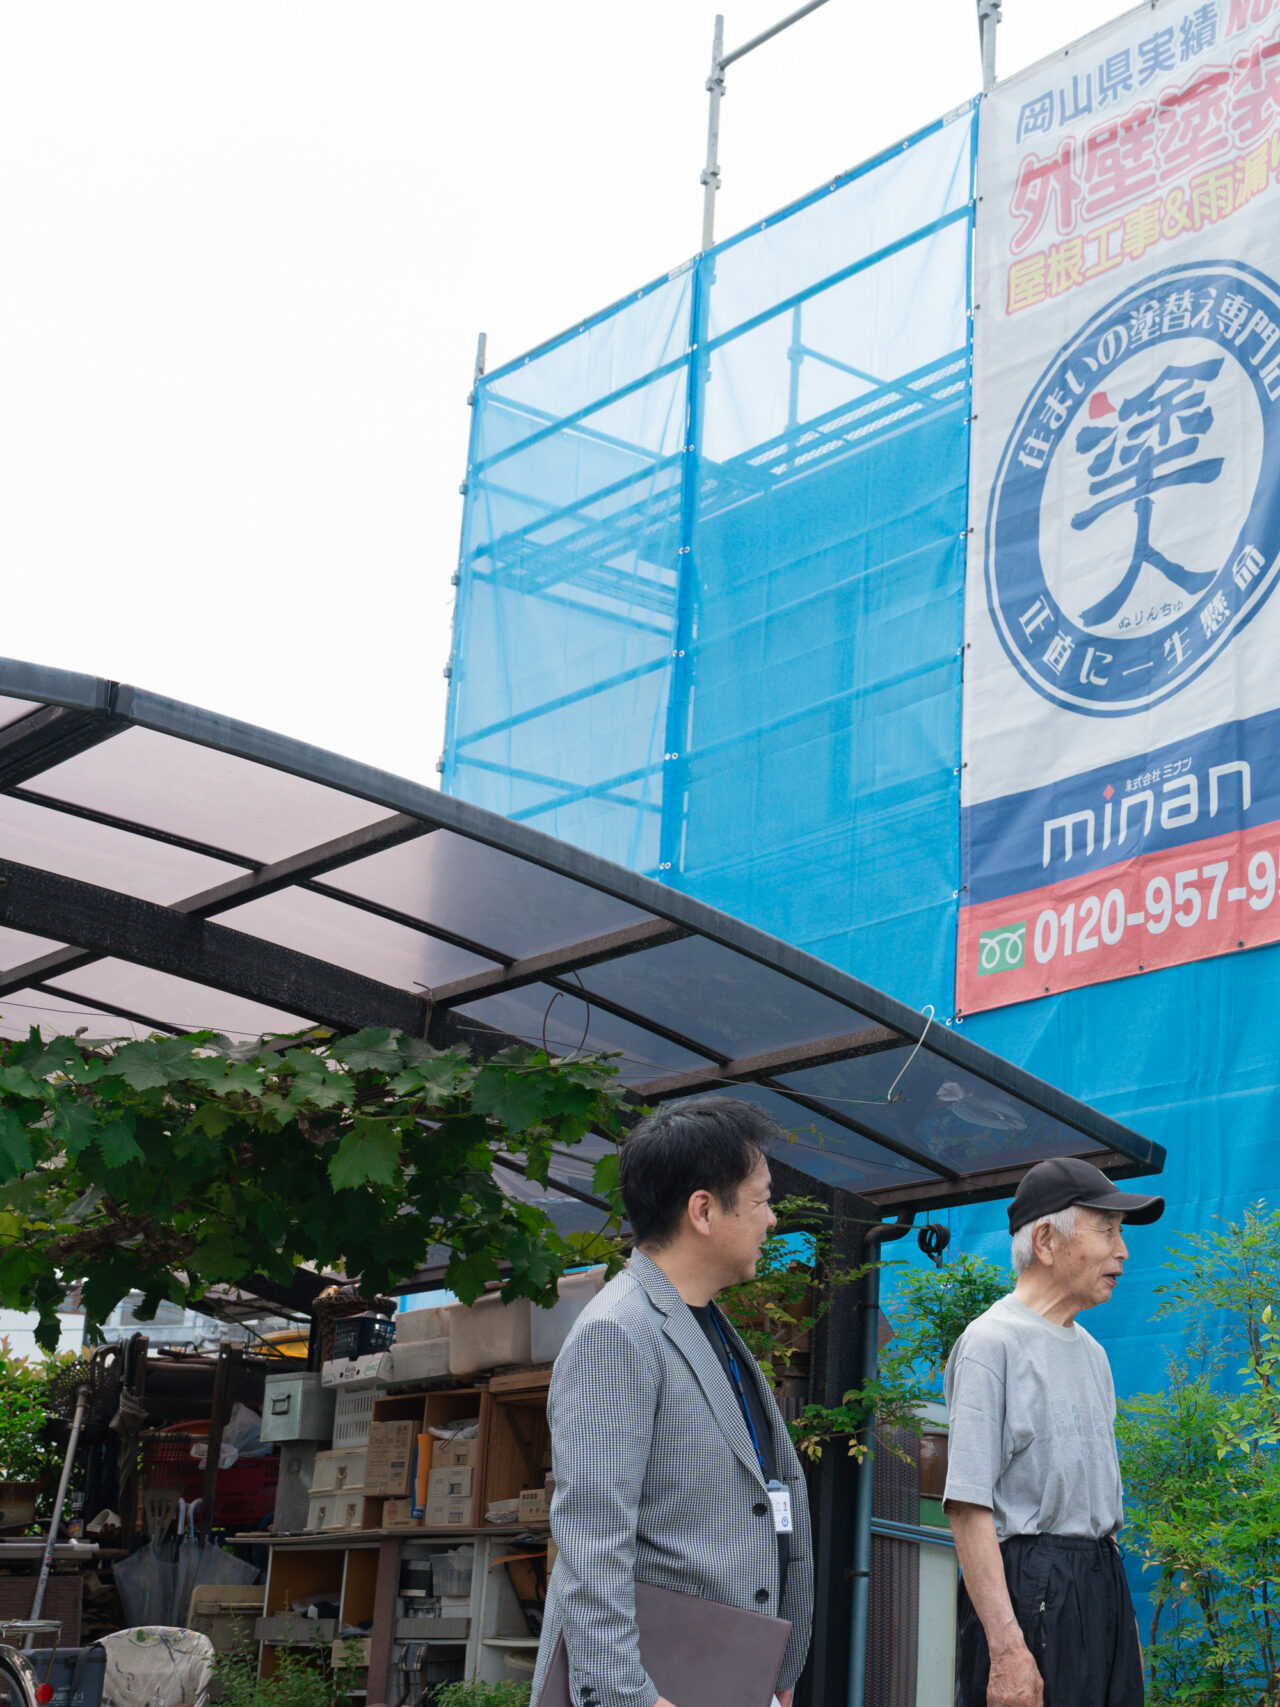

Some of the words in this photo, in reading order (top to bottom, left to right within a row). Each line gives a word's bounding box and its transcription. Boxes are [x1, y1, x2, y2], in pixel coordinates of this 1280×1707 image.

[1016, 1, 1218, 144] 岡山県実績
[1018, 543, 1266, 686] 正直に一生懸命
[1118, 600, 1184, 630] ぬりんちゅ
[1043, 760, 1251, 869] minan
